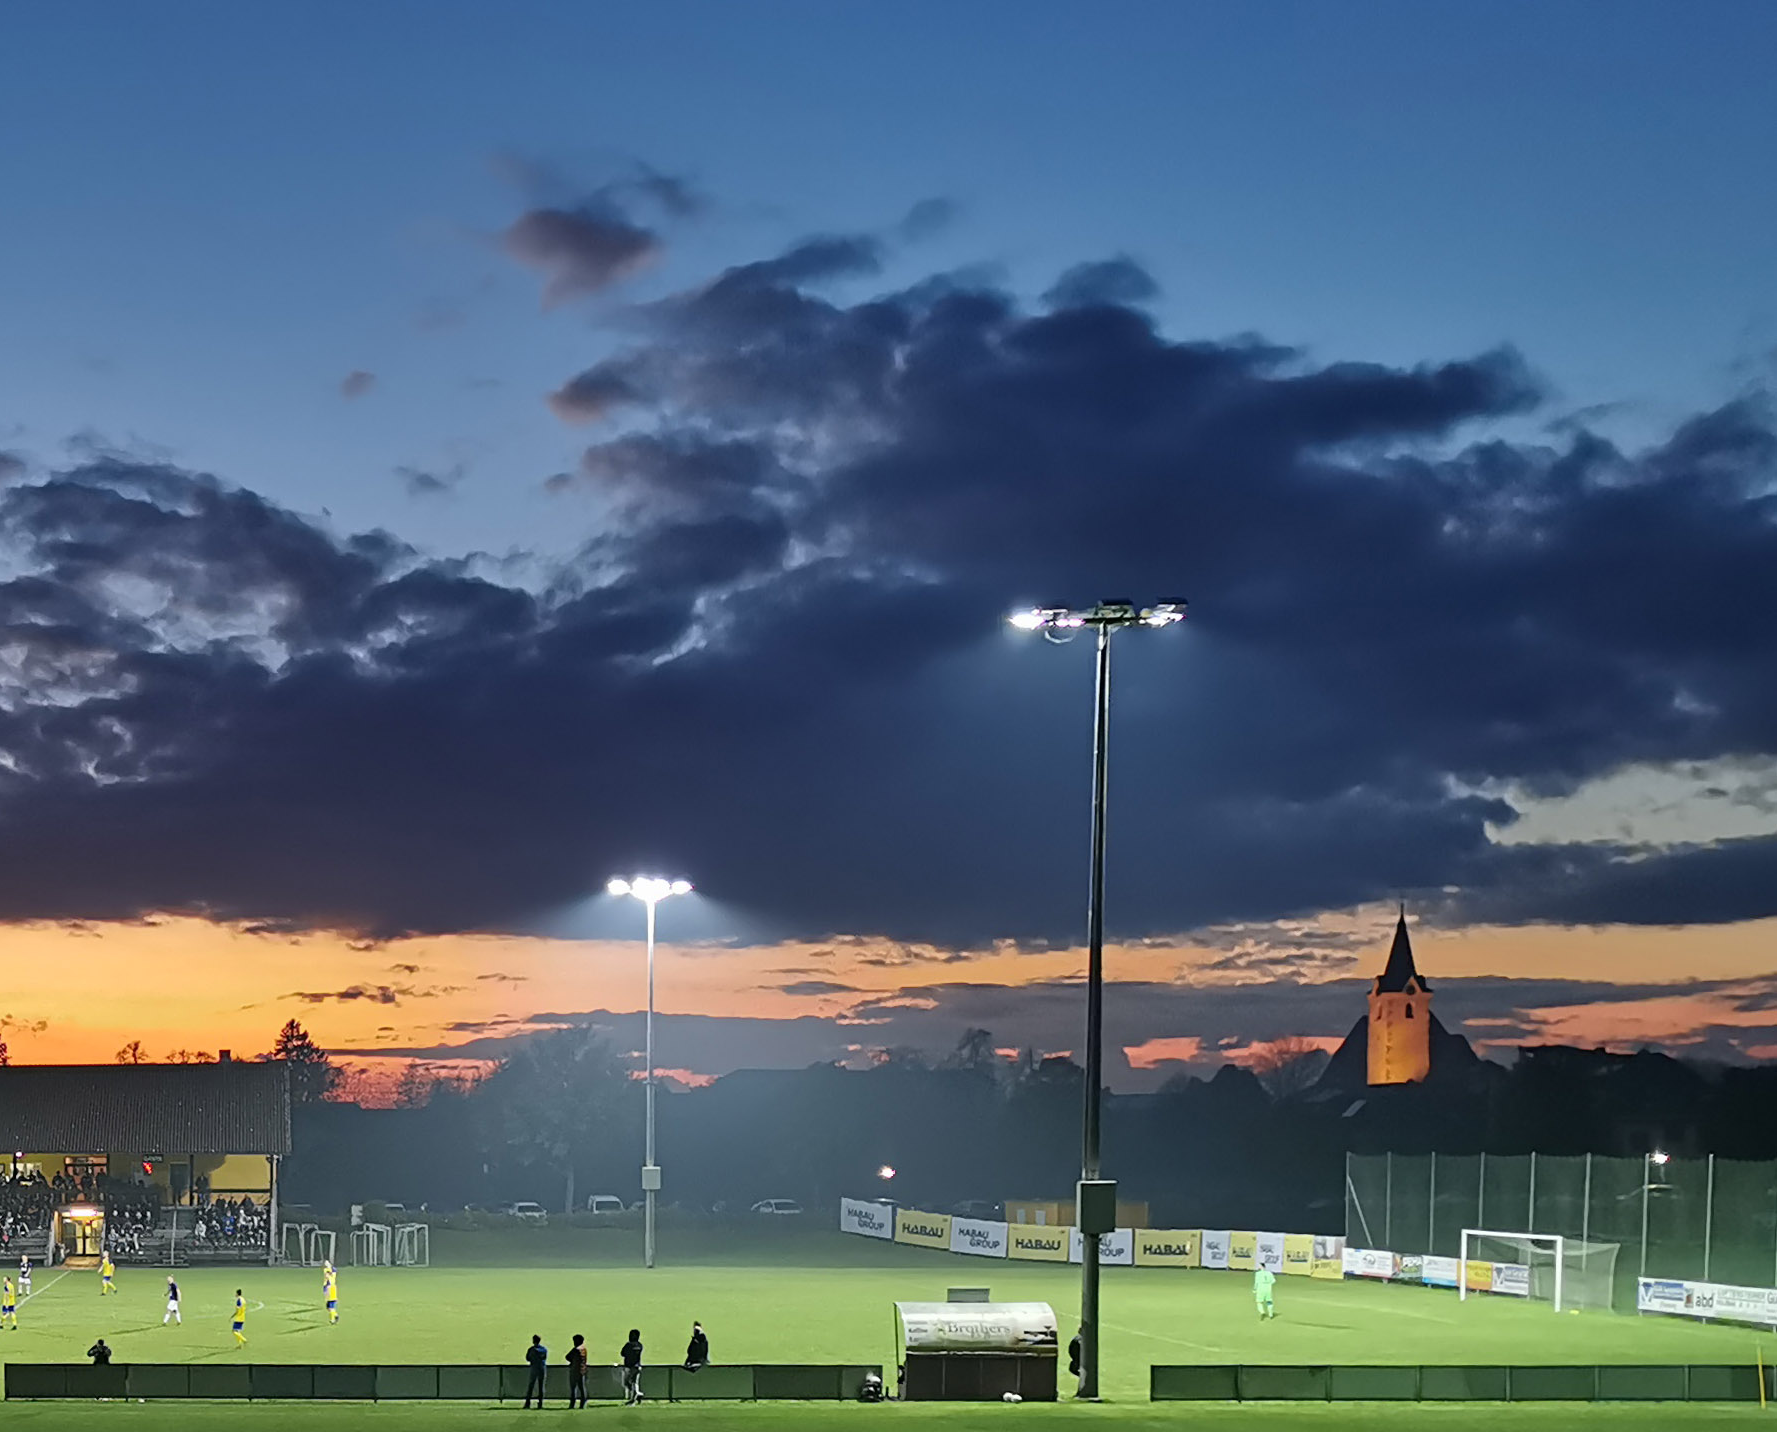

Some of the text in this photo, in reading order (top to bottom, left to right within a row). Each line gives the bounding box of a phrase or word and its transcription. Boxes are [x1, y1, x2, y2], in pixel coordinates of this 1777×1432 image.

[848, 1208, 874, 1220] HABAU
[858, 1217, 884, 1231] GROUP
[902, 1223, 943, 1238] HABAU
[959, 1228, 989, 1239] HABAU
[969, 1238, 1000, 1249] GROUP
[1015, 1238, 1061, 1251] HABAU
[947, 1323, 1011, 1337] Brothers
